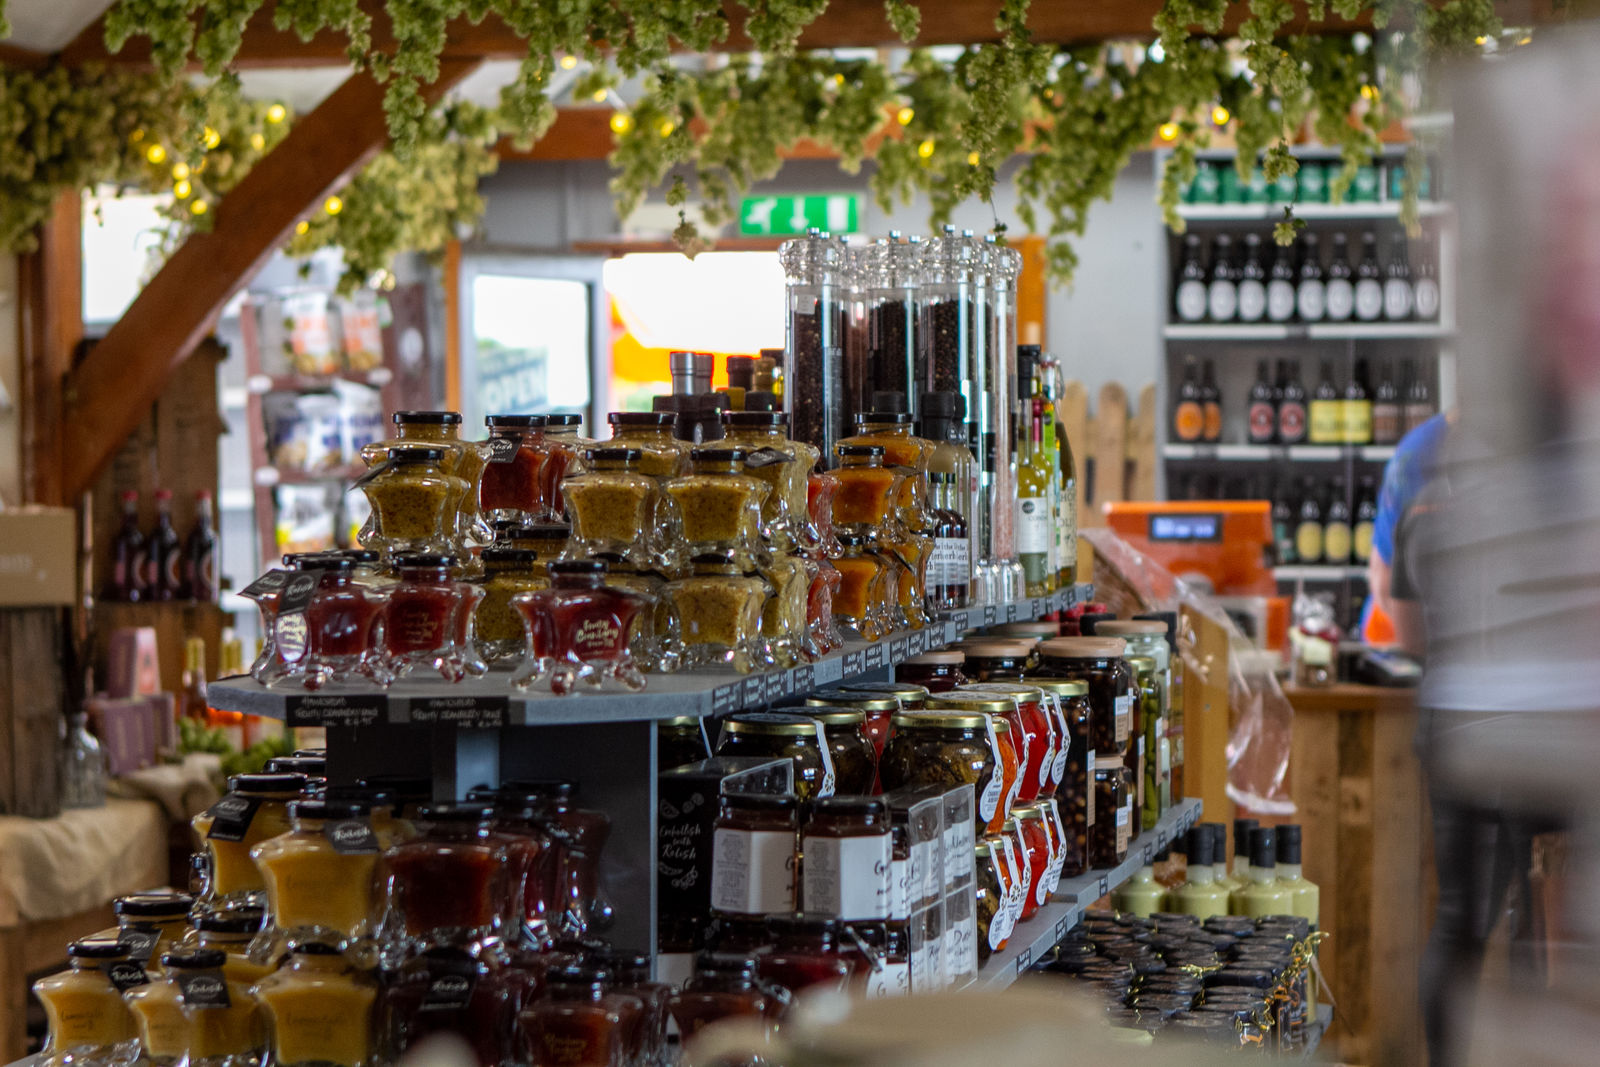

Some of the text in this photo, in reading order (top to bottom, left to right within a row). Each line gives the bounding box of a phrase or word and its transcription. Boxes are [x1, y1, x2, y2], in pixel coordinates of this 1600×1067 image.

[331, 826, 370, 840] Relish
[662, 844, 696, 860] Relish
[187, 982, 223, 993] Relish
